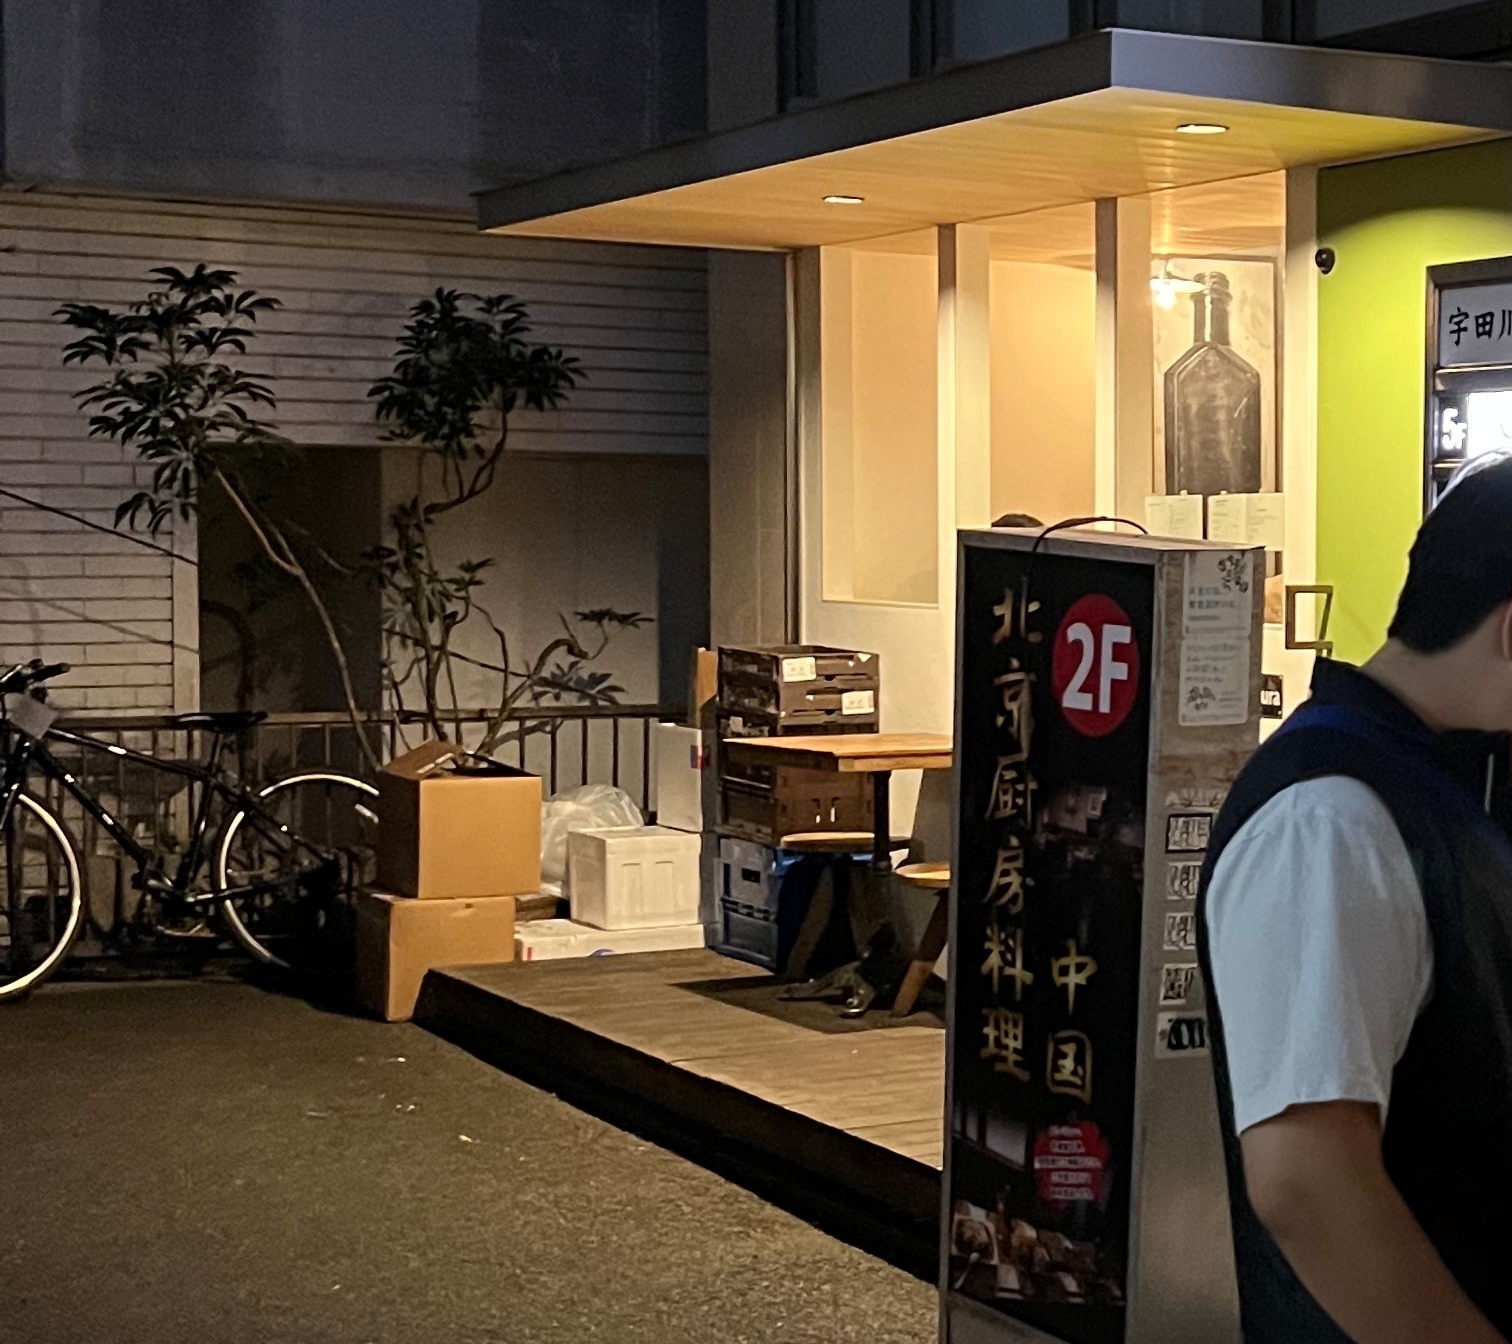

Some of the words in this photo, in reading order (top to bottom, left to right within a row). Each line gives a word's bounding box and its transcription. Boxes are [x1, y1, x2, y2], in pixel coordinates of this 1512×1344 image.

[1442, 408, 1467, 449] 5F
[1061, 622, 1132, 714] 2F
[979, 575, 1044, 1083] 北京厨房料理
[1047, 939, 1099, 1104] 中国
